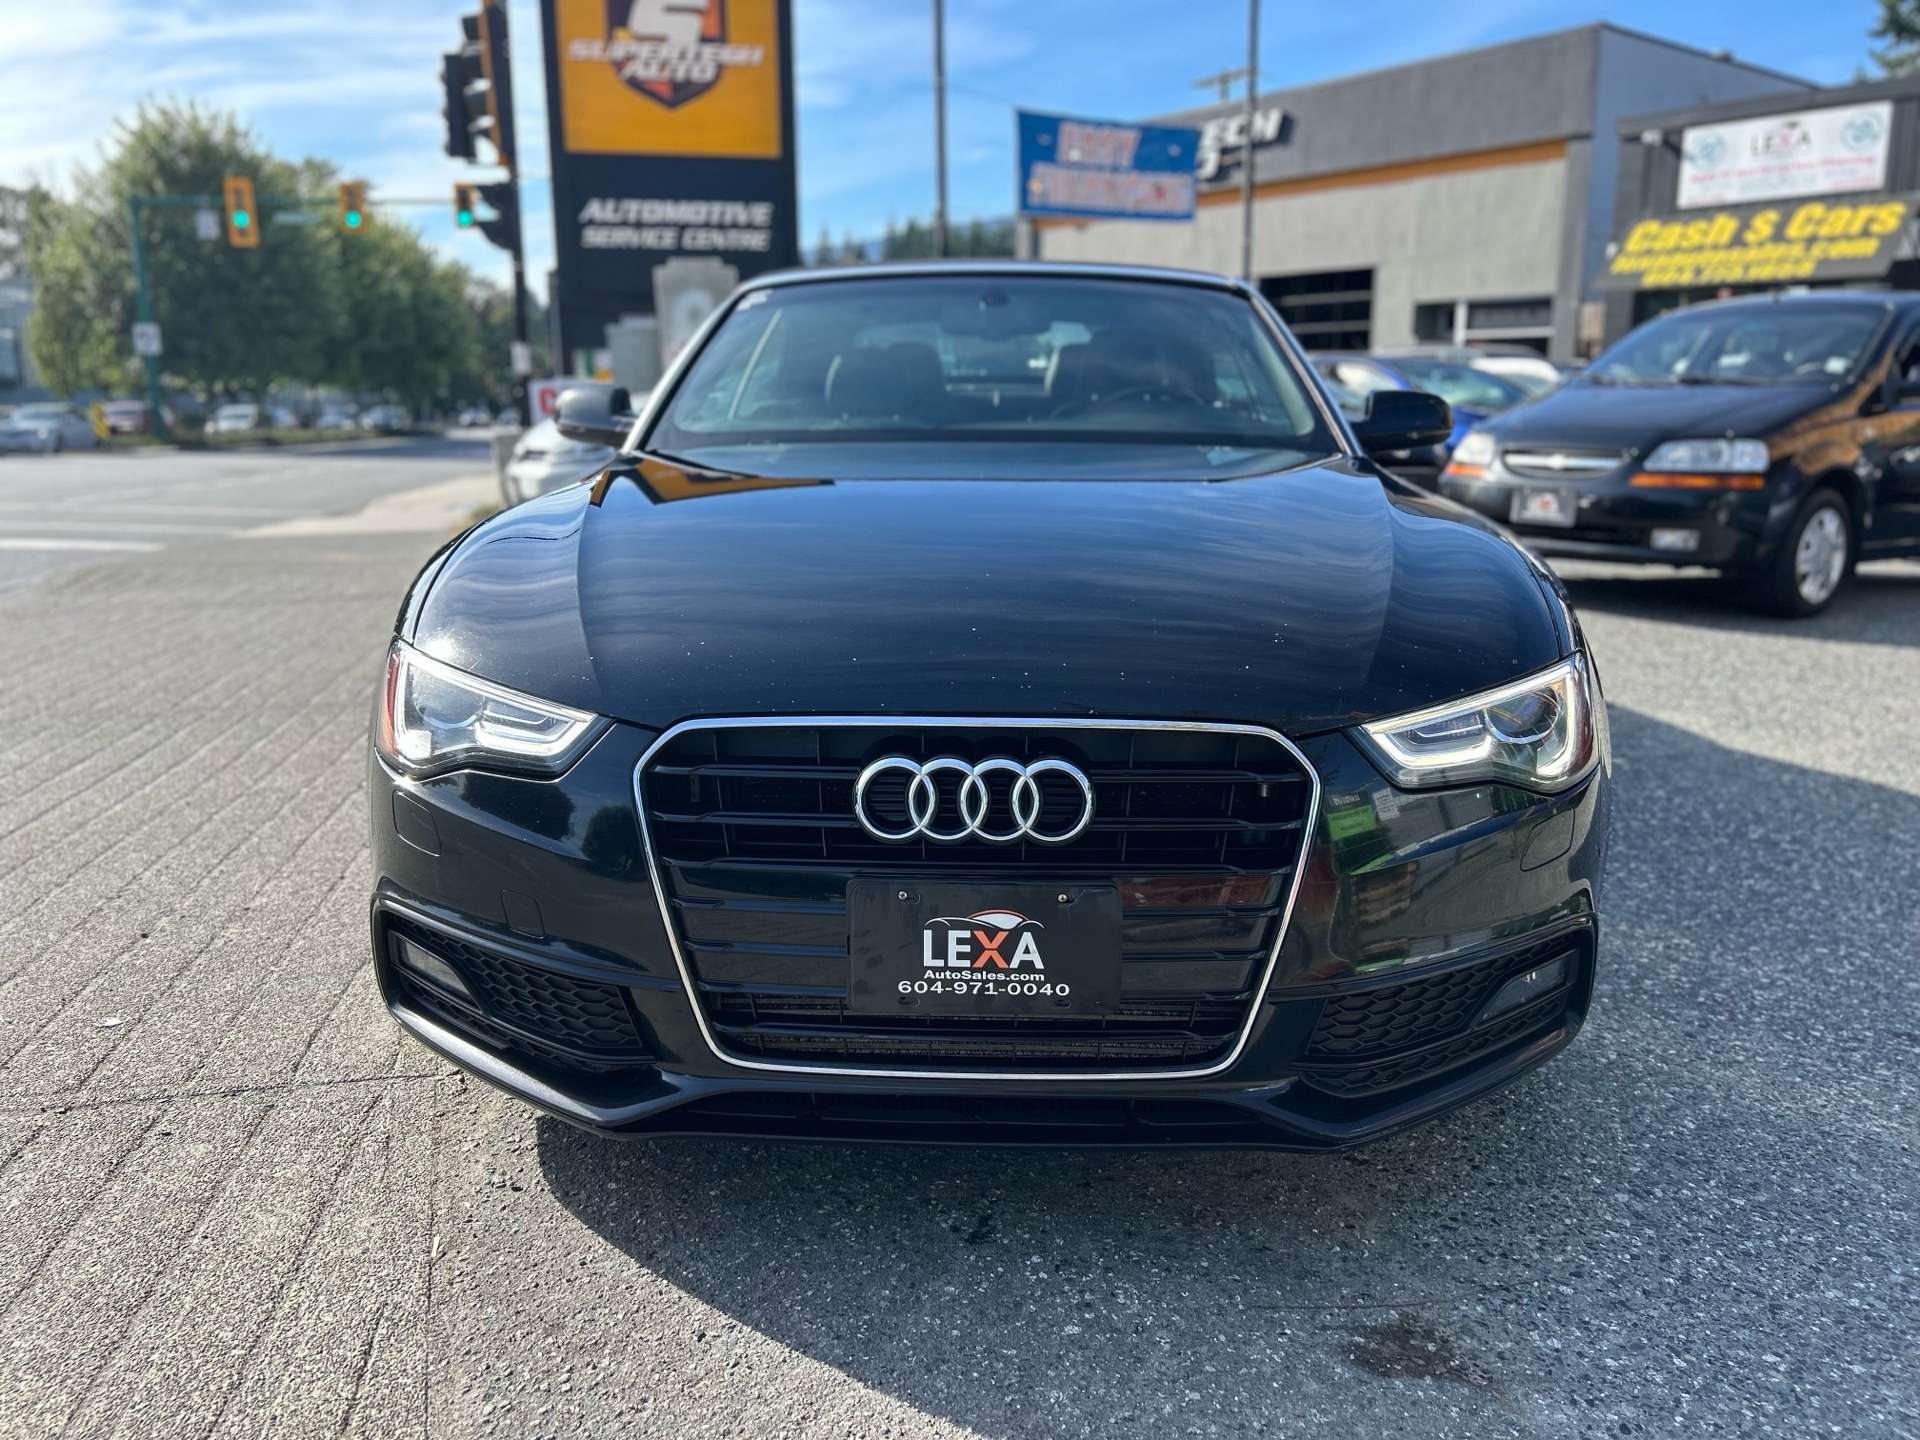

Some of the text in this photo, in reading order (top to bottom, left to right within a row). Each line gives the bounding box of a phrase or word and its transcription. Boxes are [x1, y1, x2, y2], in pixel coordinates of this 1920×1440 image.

[619, 62, 720, 84] AUTO
[578, 198, 774, 226] AUTOMOTIVE
[579, 225, 771, 251] SERVICE CENTRE
[1624, 212, 1739, 253] Cash
[1784, 201, 1906, 241] Cars
[923, 929, 1045, 970] LEXA
[897, 981, 1070, 996] 604-971-0040
[923, 969, 1045, 982] AutoSales.com
